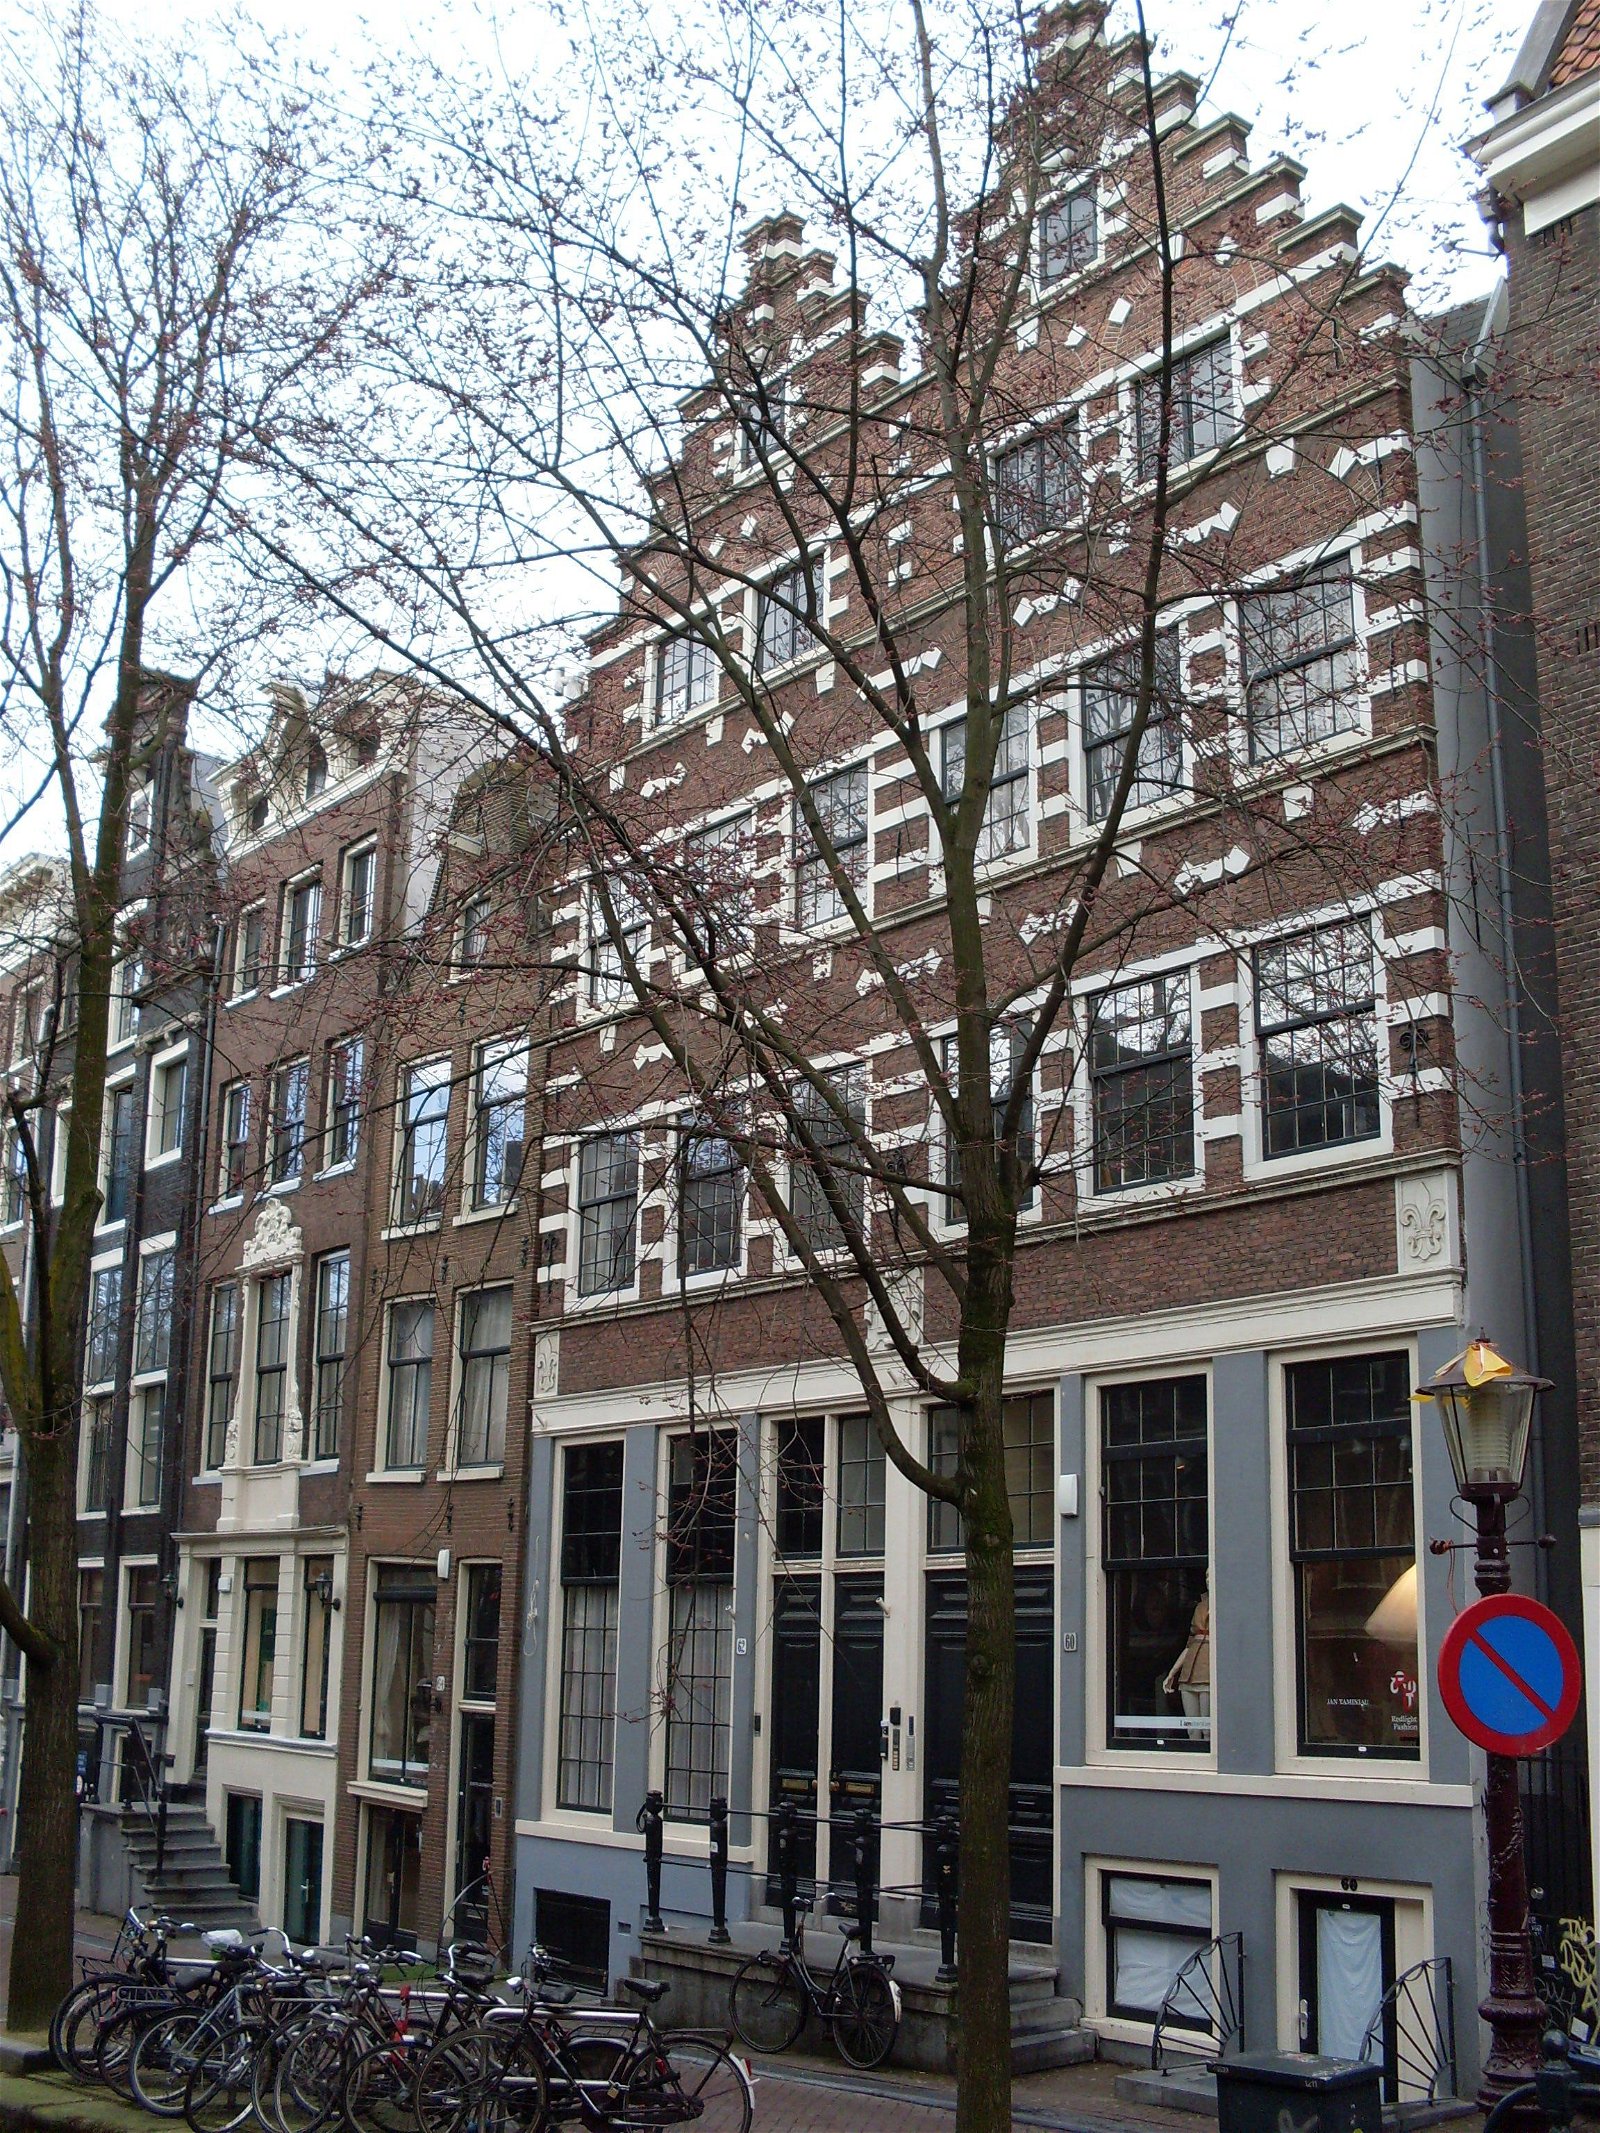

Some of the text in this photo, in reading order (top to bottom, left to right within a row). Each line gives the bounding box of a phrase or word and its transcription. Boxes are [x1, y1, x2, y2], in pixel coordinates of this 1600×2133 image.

[738, 1639, 746, 1653] 62
[1065, 1633, 1075, 1650] 60
[1391, 1715, 1417, 1725] Redlight
[1393, 1723, 1418, 1731] Fashion
[1341, 1877, 1358, 1891] 60
